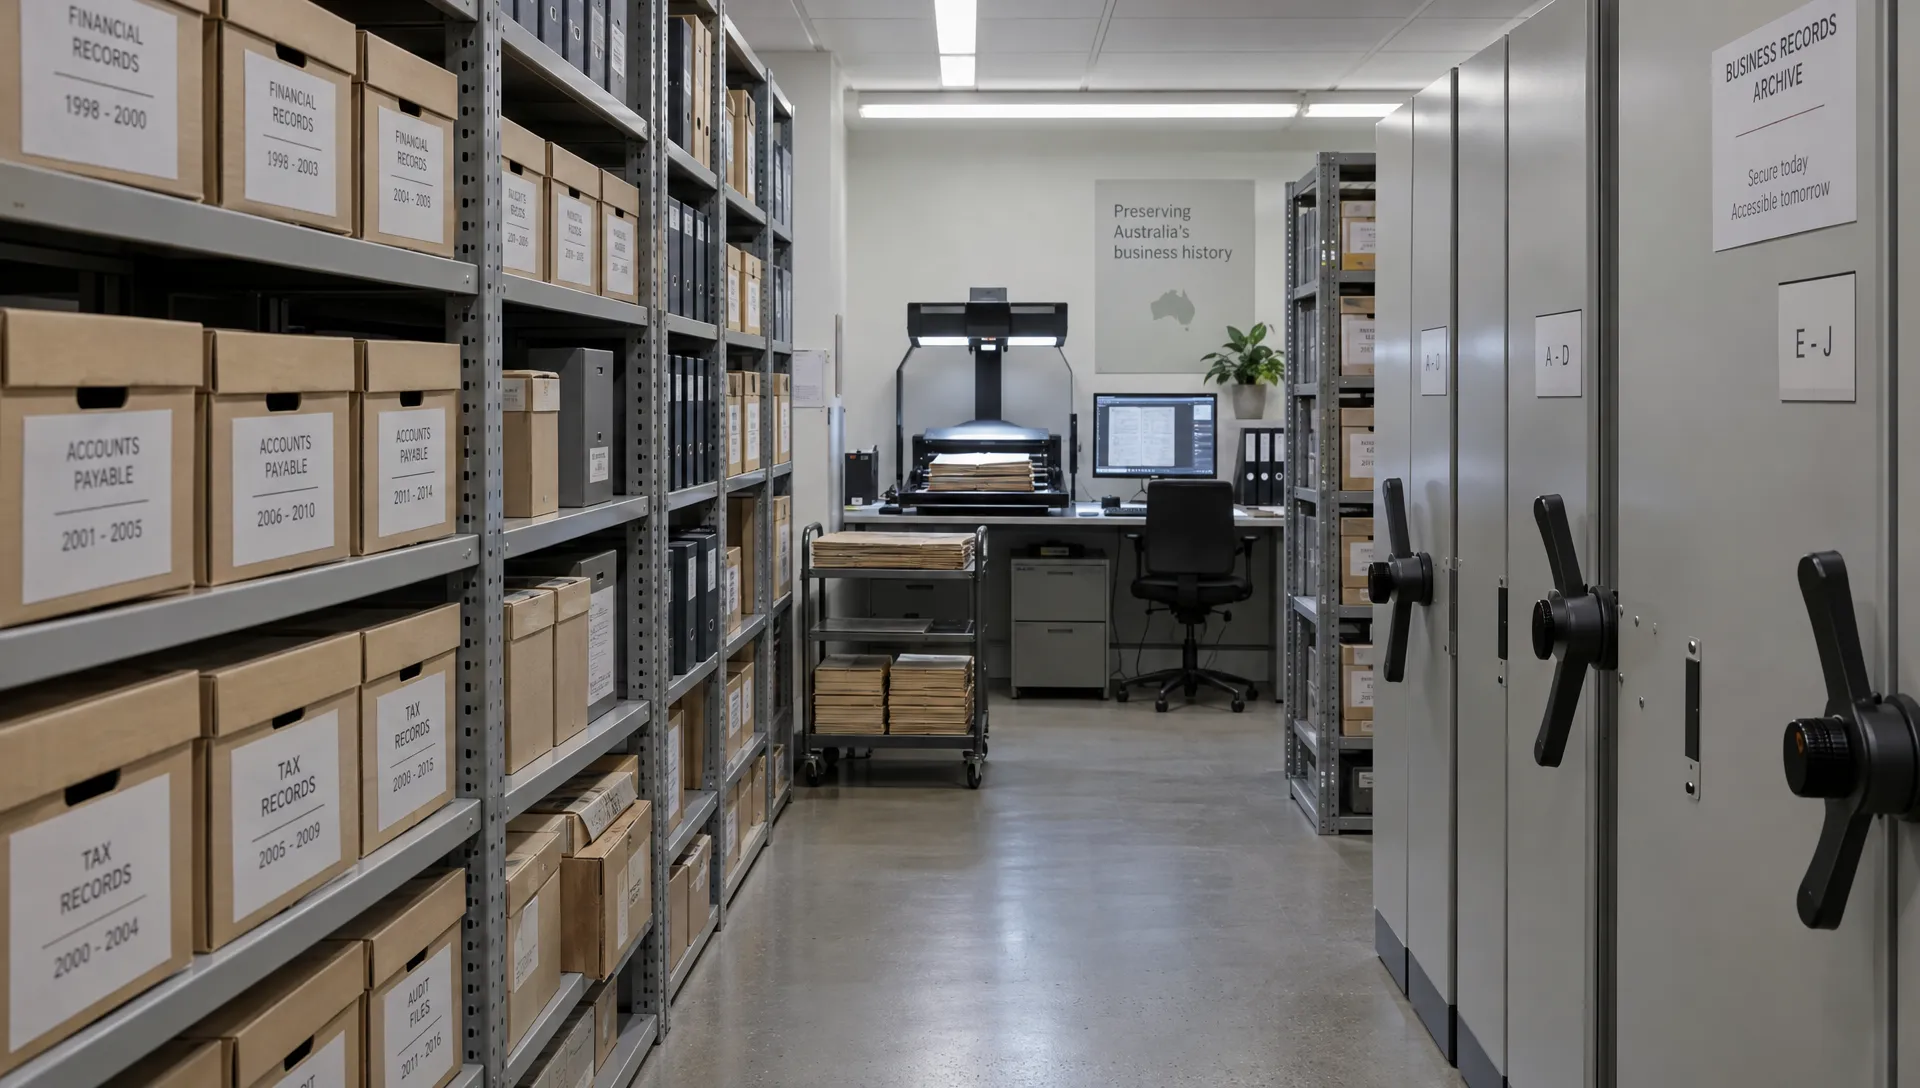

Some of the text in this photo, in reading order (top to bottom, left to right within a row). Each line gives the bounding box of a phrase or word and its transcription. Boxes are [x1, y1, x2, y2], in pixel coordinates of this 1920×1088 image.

[69, 5, 144, 46] FINANCIAL
[72, 36, 140, 73] RECORDS
[1726, 13, 1837, 83] BUSINESS RECORDS
[269, 80, 317, 111] FINANCIAL
[1752, 62, 1803, 103] ARCHIVE
[65, 94, 100, 120] 1998
[114, 105, 147, 130] 2000
[272, 106, 314, 133] RECORDS
[395, 129, 429, 153] FINANCIAL
[267, 150, 289, 170] 1998
[297, 158, 319, 177] 2003
[397, 150, 427, 172] RECORDS
[1748, 154, 1809, 187] Secure today
[1114, 203, 1191, 222] Preserving
[1731, 180, 1831, 221] Accessible tomorrow
[1113, 224, 1190, 239] Australia's
[1114, 244, 1233, 263] business history
[1545, 346, 1553, 367] A
[1562, 344, 1570, 366] D
[1796, 328, 1806, 359] E
[1823, 325, 1832, 357] J
[66, 436, 141, 462] ACCOUNTS
[259, 434, 312, 455] ACCOUNTS
[396, 426, 431, 444] ACCOUNTS
[265, 457, 308, 478] PAYABLE
[400, 446, 428, 464] PAYABLE
[74, 465, 134, 491] PAYABLE
[394, 488, 410, 505] 2011
[417, 484, 433, 501] 2014
[257, 507, 283, 528] 2006
[292, 502, 315, 521] 2010
[62, 526, 95, 552] 2001
[110, 518, 142, 543] 2005
[405, 701, 421, 721] TAX
[394, 718, 430, 750] RECORDS
[278, 754, 301, 781] TAX
[261, 775, 316, 818] RECORDS
[81, 840, 112, 872] TAX
[258, 840, 286, 870] 2005
[296, 821, 320, 849] 2009
[60, 863, 132, 917] RECORDS
[53, 942, 92, 980] 2000
[104, 916, 139, 952] 2004
[407, 977, 430, 1008] AUDIT
[409, 999, 431, 1029] FILES
[401, 1053, 419, 1080] 2011
[424, 1031, 442, 1058] 2016
